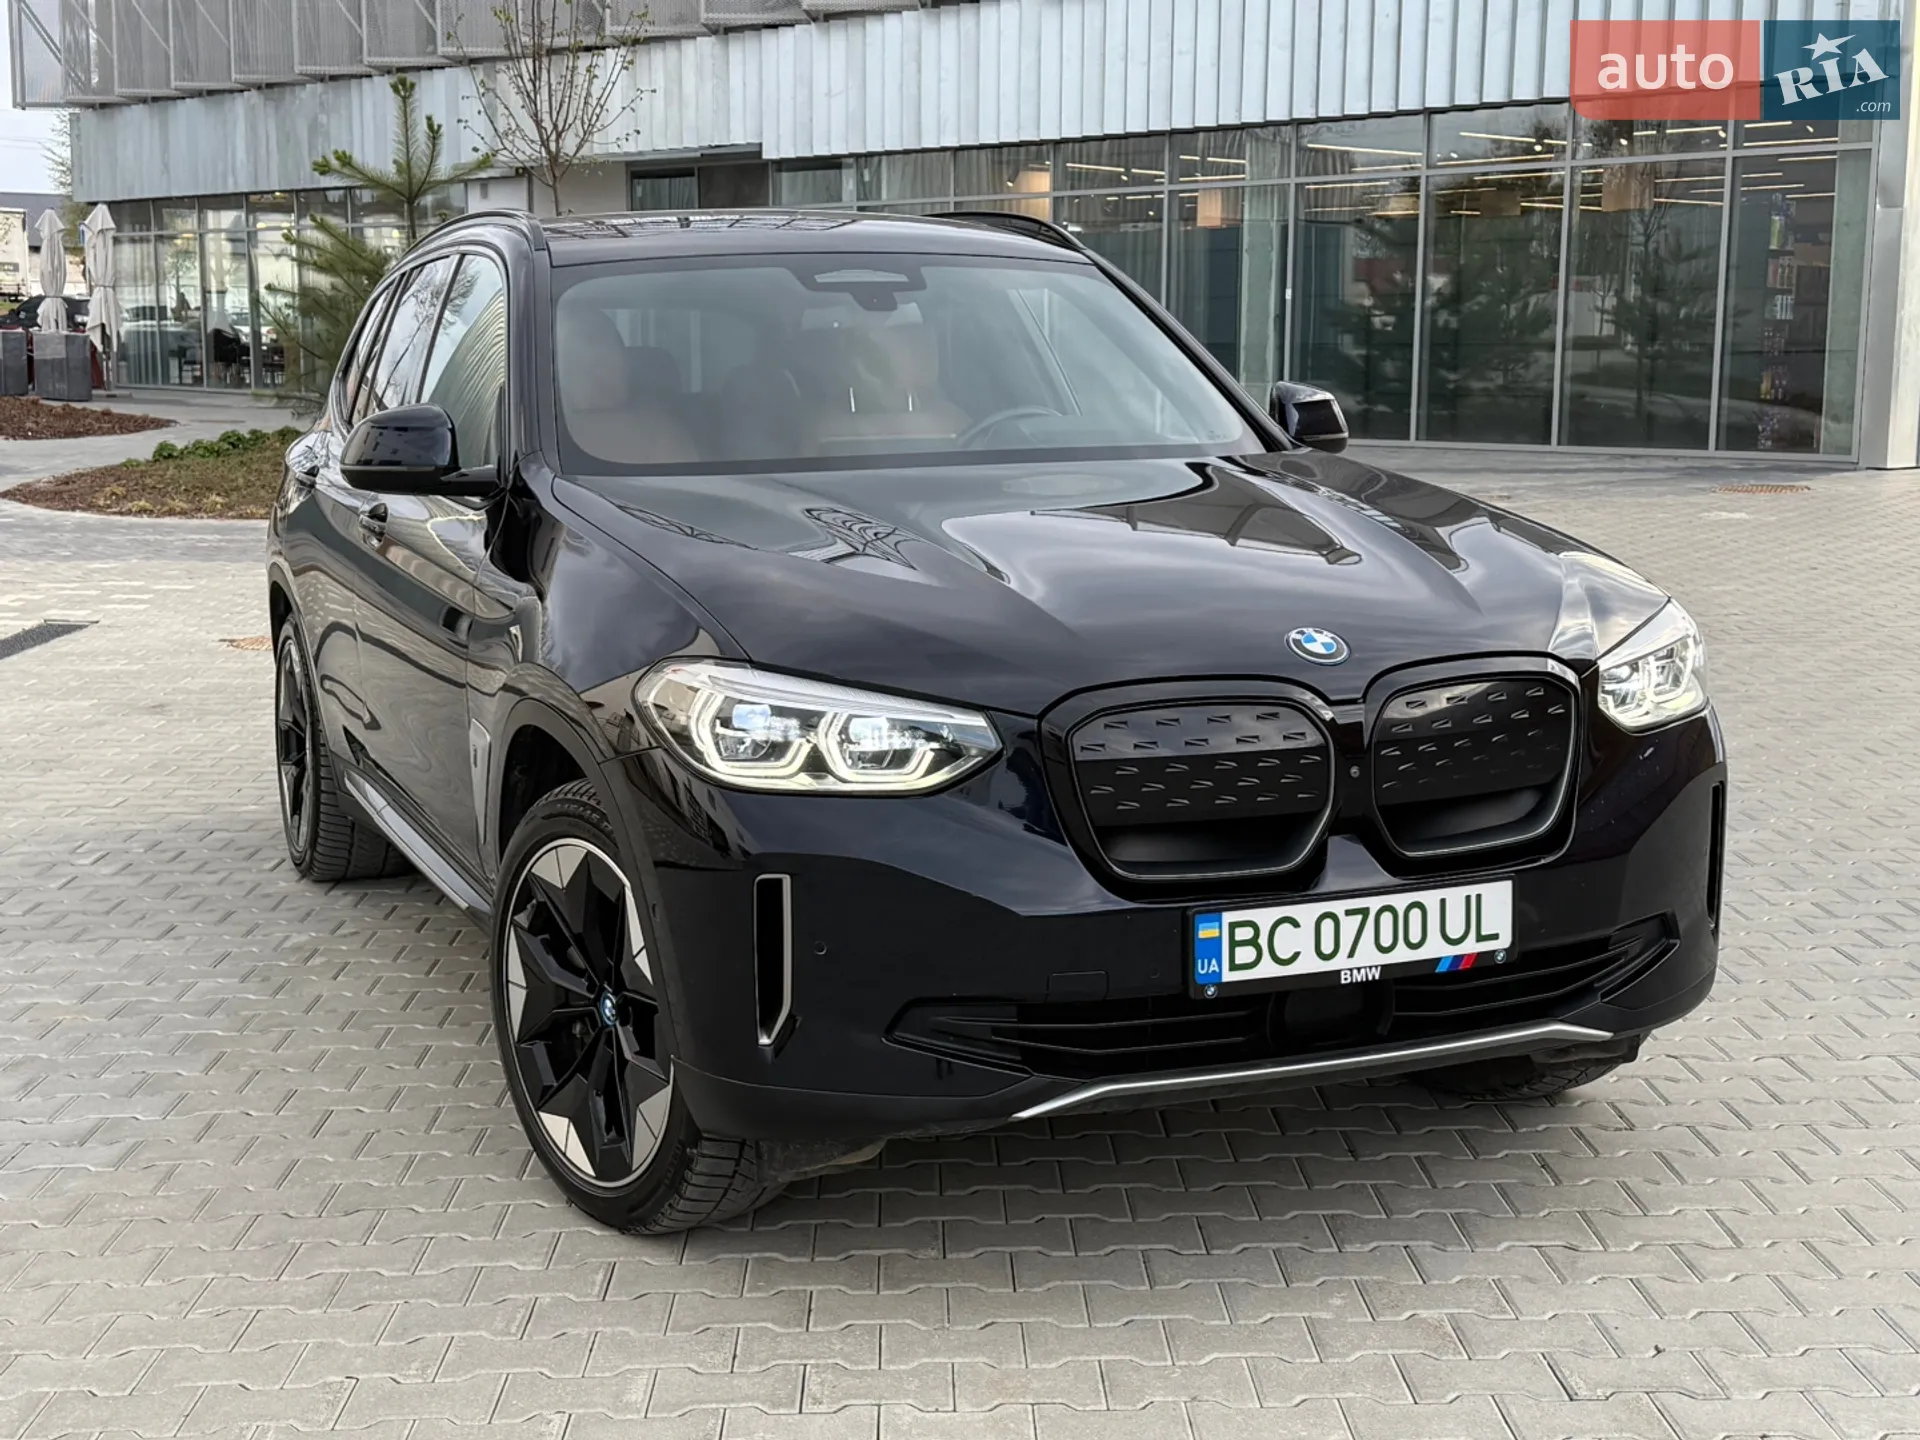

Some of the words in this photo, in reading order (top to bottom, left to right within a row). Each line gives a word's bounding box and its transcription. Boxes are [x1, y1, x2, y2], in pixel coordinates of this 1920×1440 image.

[1228, 916, 1302, 972] BC
[1314, 900, 1428, 962] 0700
[1440, 893, 1500, 946] UL
[1197, 957, 1219, 975] UA
[1340, 966, 1381, 984] BMW
